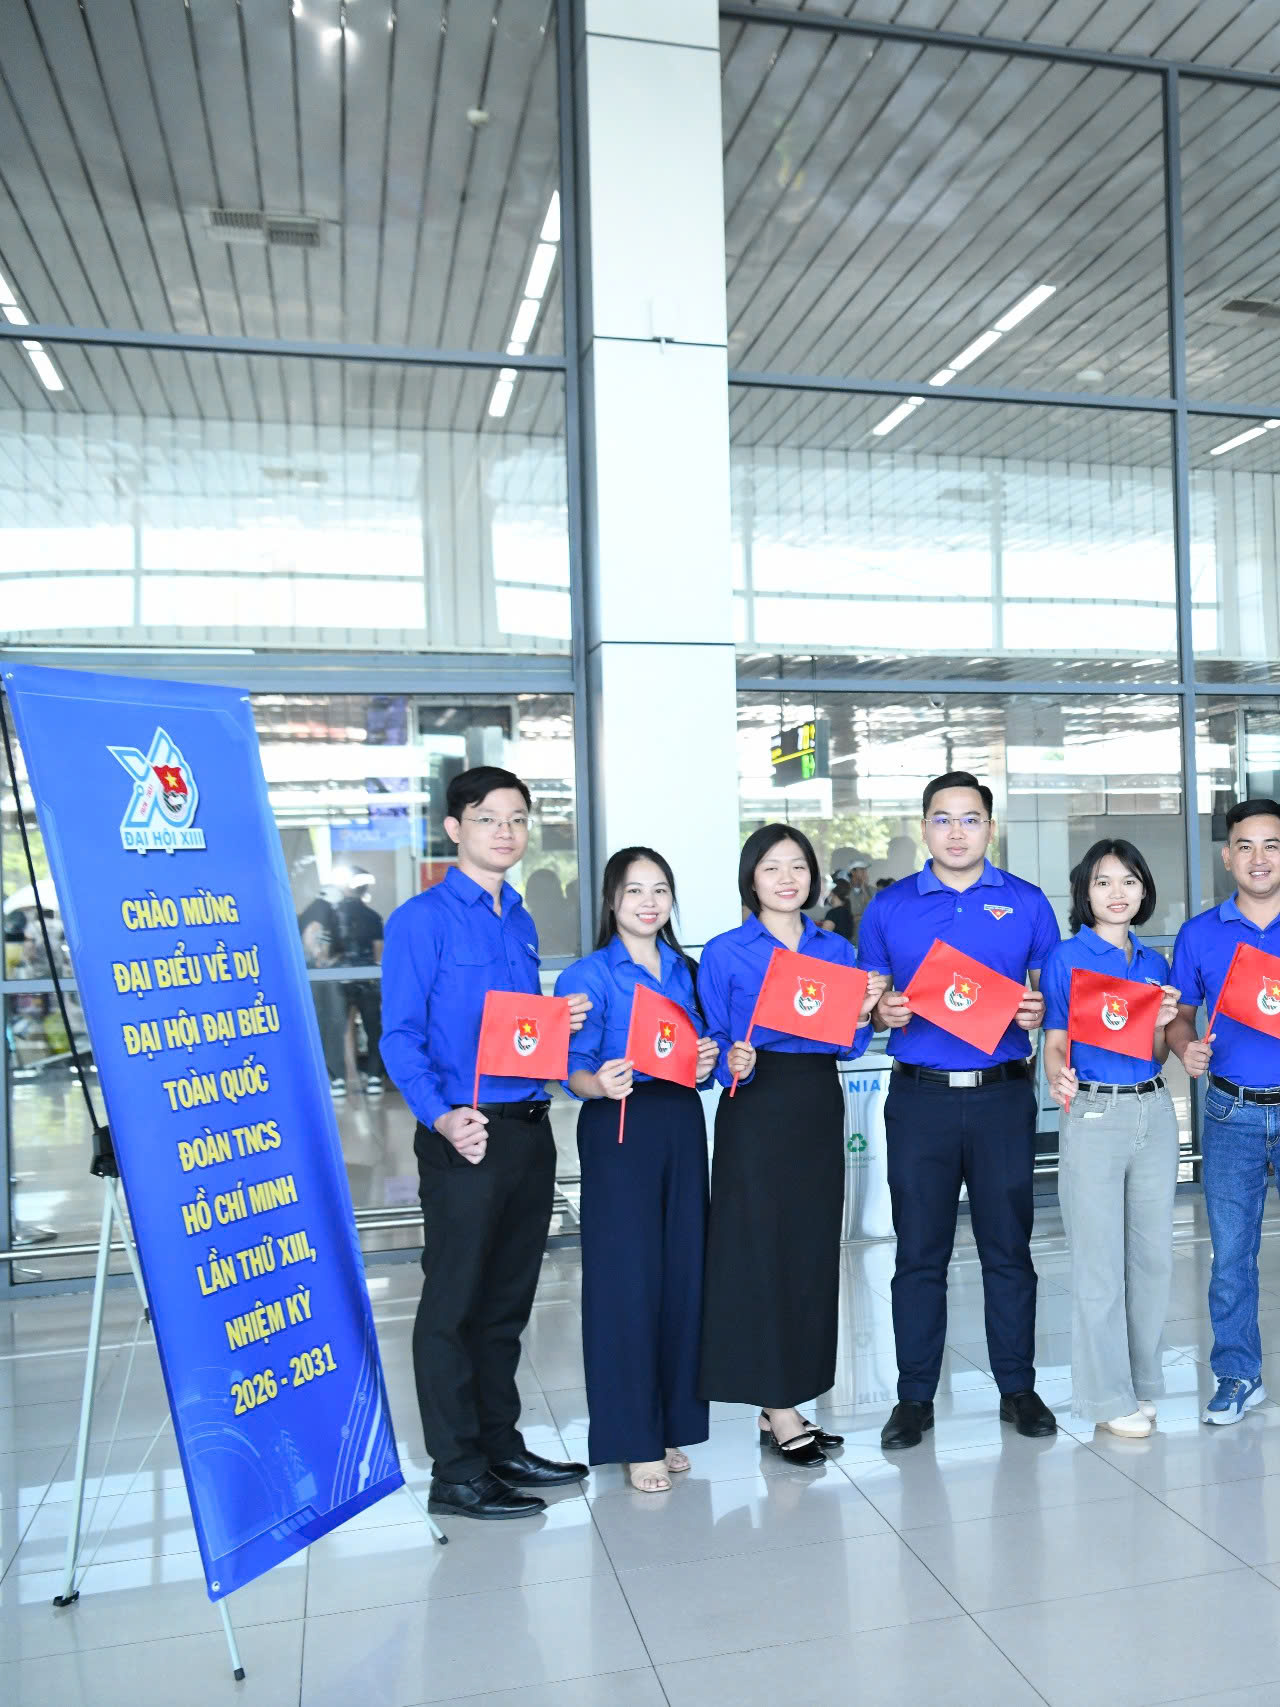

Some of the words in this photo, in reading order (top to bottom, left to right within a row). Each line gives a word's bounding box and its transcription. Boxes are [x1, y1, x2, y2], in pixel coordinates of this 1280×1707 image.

[180, 831, 203, 845] XIII
[121, 891, 179, 930] CHÀO
[183, 889, 239, 926] MỪNG
[112, 961, 153, 998] ĐẠI
[156, 942, 202, 987] BIỂU
[202, 941, 231, 983] VỀ
[235, 945, 261, 985] DỰ
[122, 1022, 161, 1060] ĐẠI
[165, 1013, 200, 1052] HỘI
[201, 1011, 236, 1050] ĐẠI
[239, 992, 281, 1036] BIỂU
[163, 1067, 219, 1111] TOÀN
[220, 1055, 270, 1103] QUỐC
[848, 1080, 881, 1093] NIA
[178, 1128, 231, 1172] ĐOÀN
[232, 1120, 282, 1157] TNCS
[181, 1187, 212, 1235] HỒ
[215, 1182, 247, 1225] CHÍ
[247, 1175, 298, 1215] MINH
[196, 1247, 237, 1296] LẦN
[237, 1235, 275, 1281] THỨ
[277, 1231, 317, 1268] XIII,
[225, 1301, 286, 1351] NHIỆM
[286, 1284, 313, 1326] KỲ
[230, 1369, 278, 1416] 2026
[289, 1343, 337, 1388] 2031
